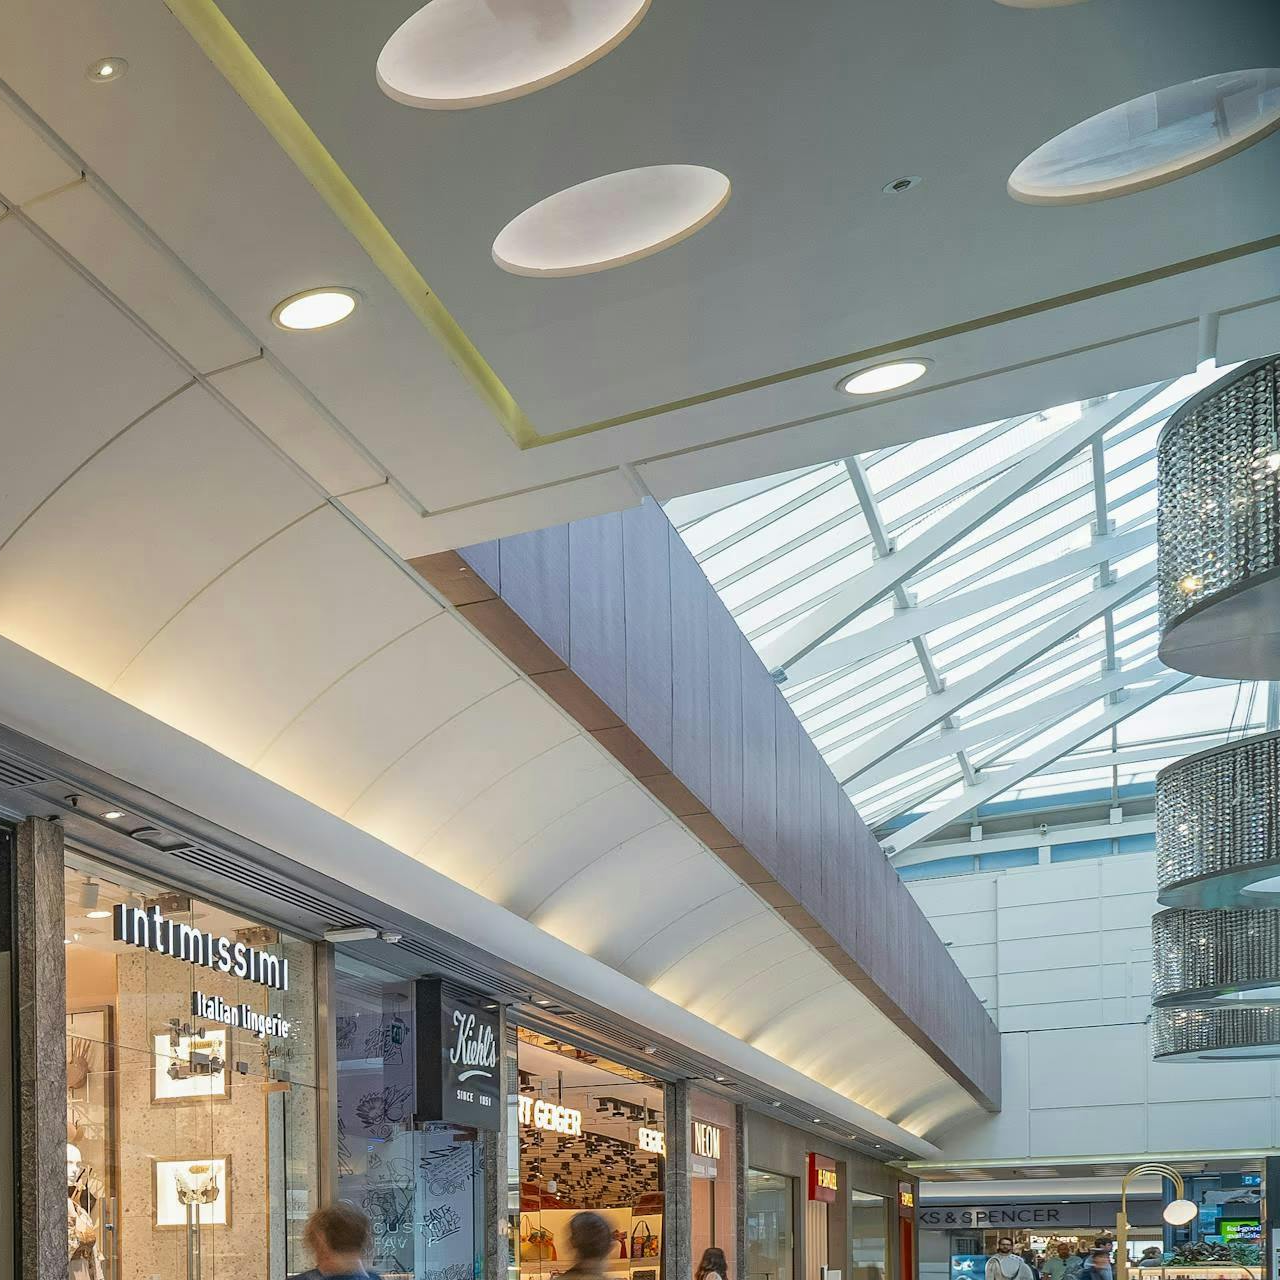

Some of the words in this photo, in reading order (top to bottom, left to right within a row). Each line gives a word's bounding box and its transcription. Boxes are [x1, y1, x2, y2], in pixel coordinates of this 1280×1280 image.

[197, 991, 239, 1026] Italian
[241, 1004, 290, 1038] lingerie
[450, 1010, 496, 1068] Kiehl's
[456, 1089, 474, 1103] SINCE
[534, 1100, 582, 1136] GEIGER
[944, 1211, 957, 1224] &
[961, 1209, 1060, 1225] SPENCER
[1030, 1235, 1051, 1247] Pay
